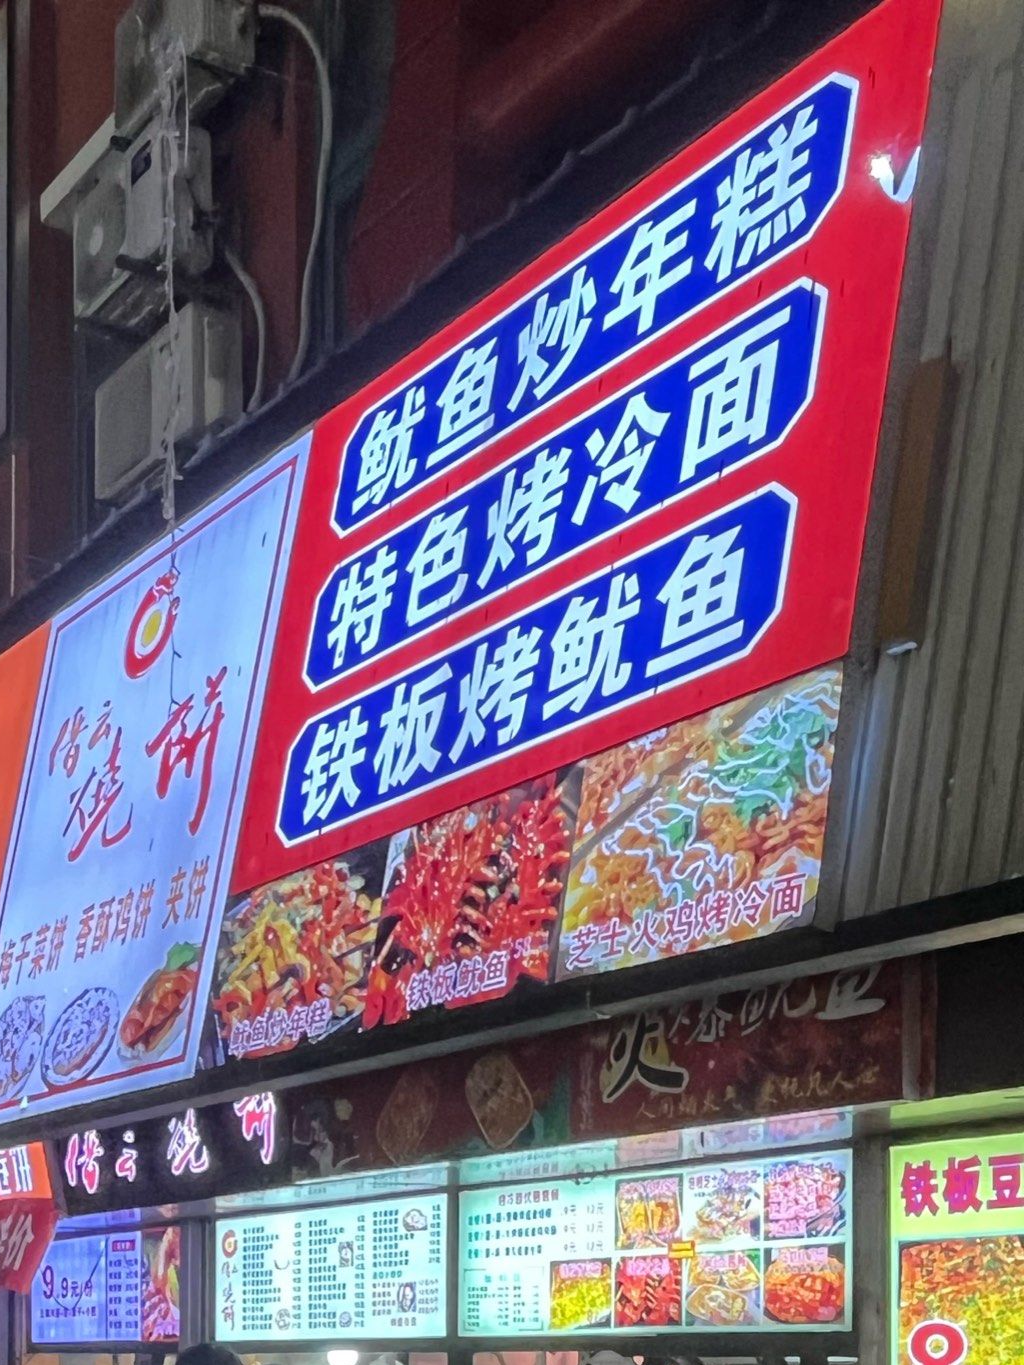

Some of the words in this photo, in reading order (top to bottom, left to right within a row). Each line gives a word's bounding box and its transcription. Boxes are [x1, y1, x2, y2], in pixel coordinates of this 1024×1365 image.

[352, 105, 819, 514] 鱿鱼炒年糕
[327, 307, 790, 669] 特色烤冷面
[301, 533, 747, 825] 铁板烤鱿鱼
[162, 856, 210, 929] 夹饼
[406, 951, 510, 1011] 铁板鱿鱼
[566, 873, 808, 970] 芝士火鸡烤冷面
